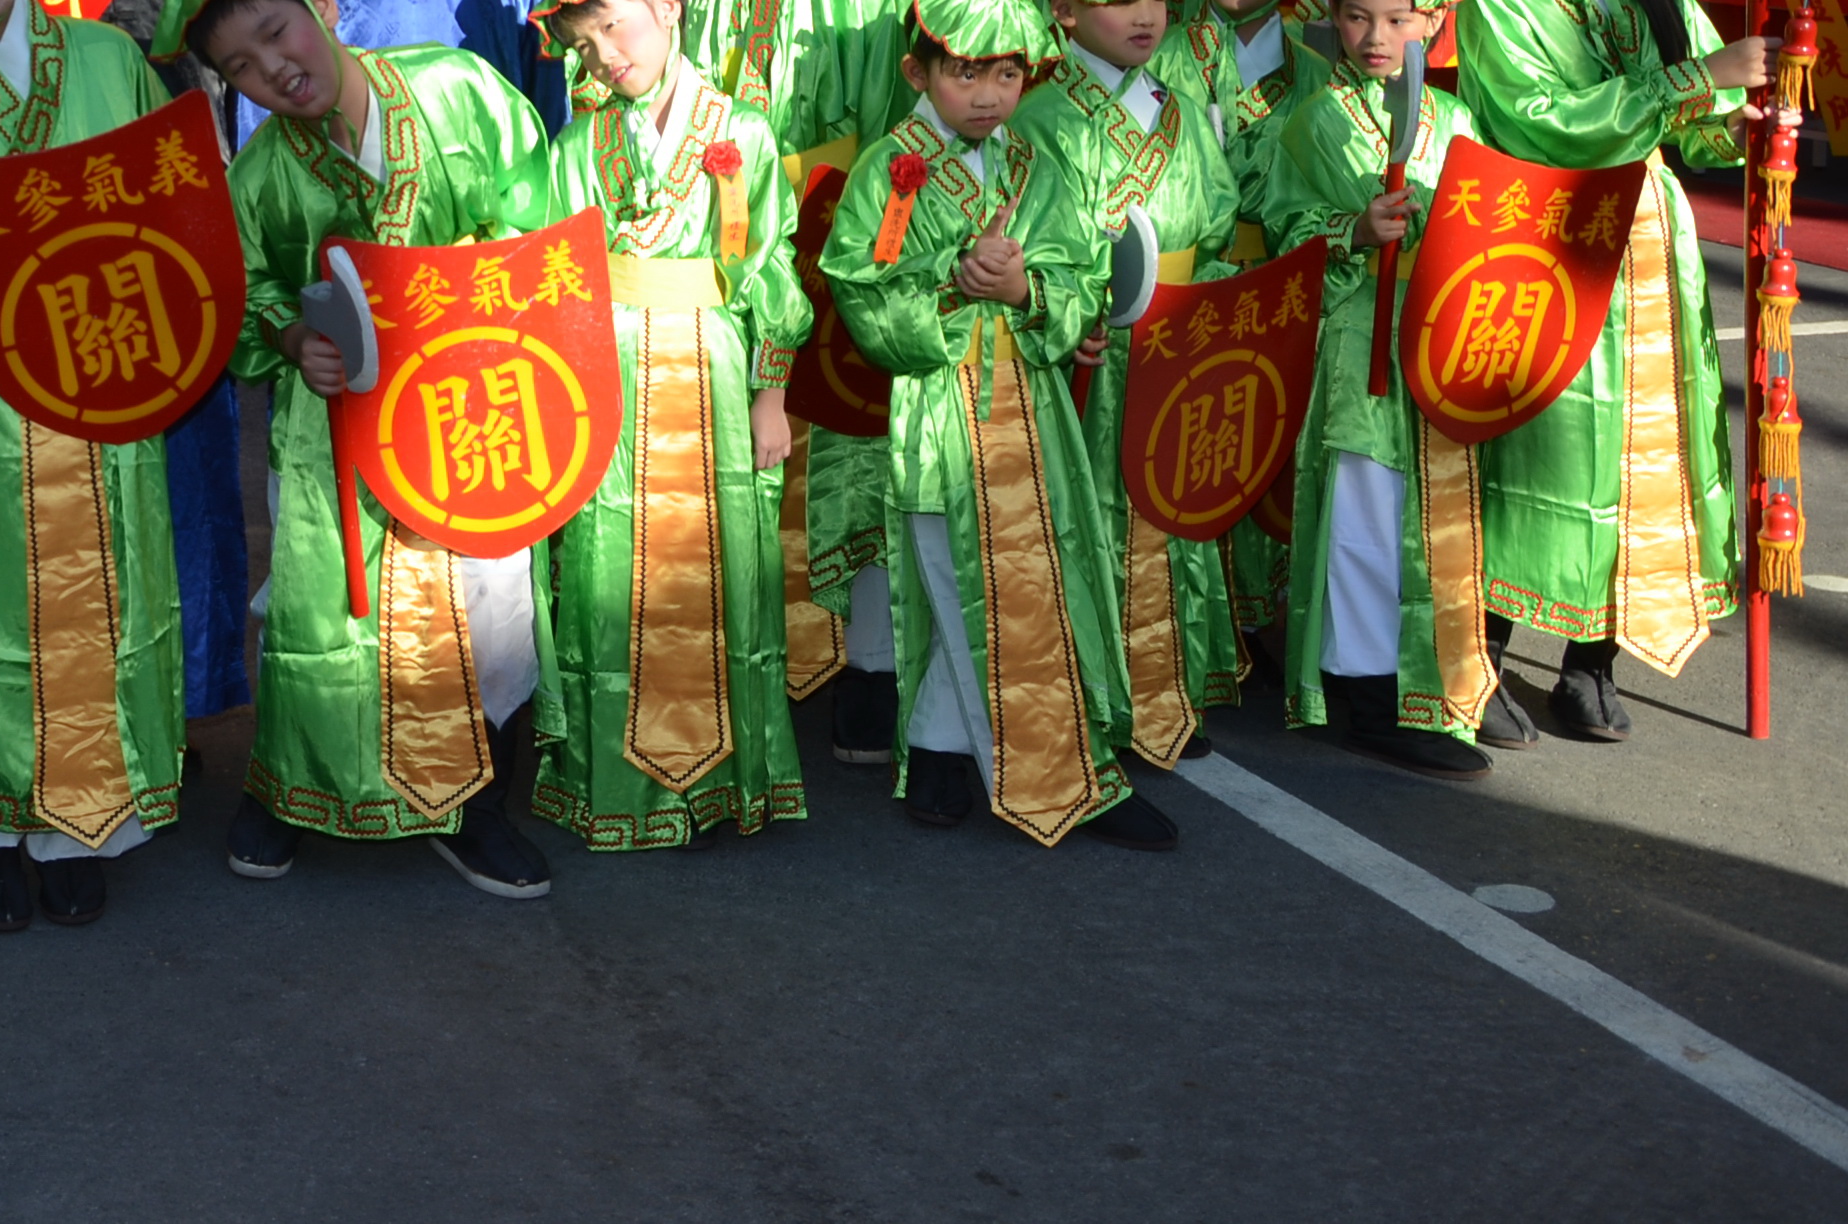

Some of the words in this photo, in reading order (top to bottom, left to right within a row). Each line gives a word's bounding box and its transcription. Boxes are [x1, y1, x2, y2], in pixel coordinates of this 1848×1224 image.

[37, 250, 180, 399] 關
[1441, 279, 1554, 398] 關
[418, 359, 552, 502] 關
[1172, 374, 1259, 501] 關
